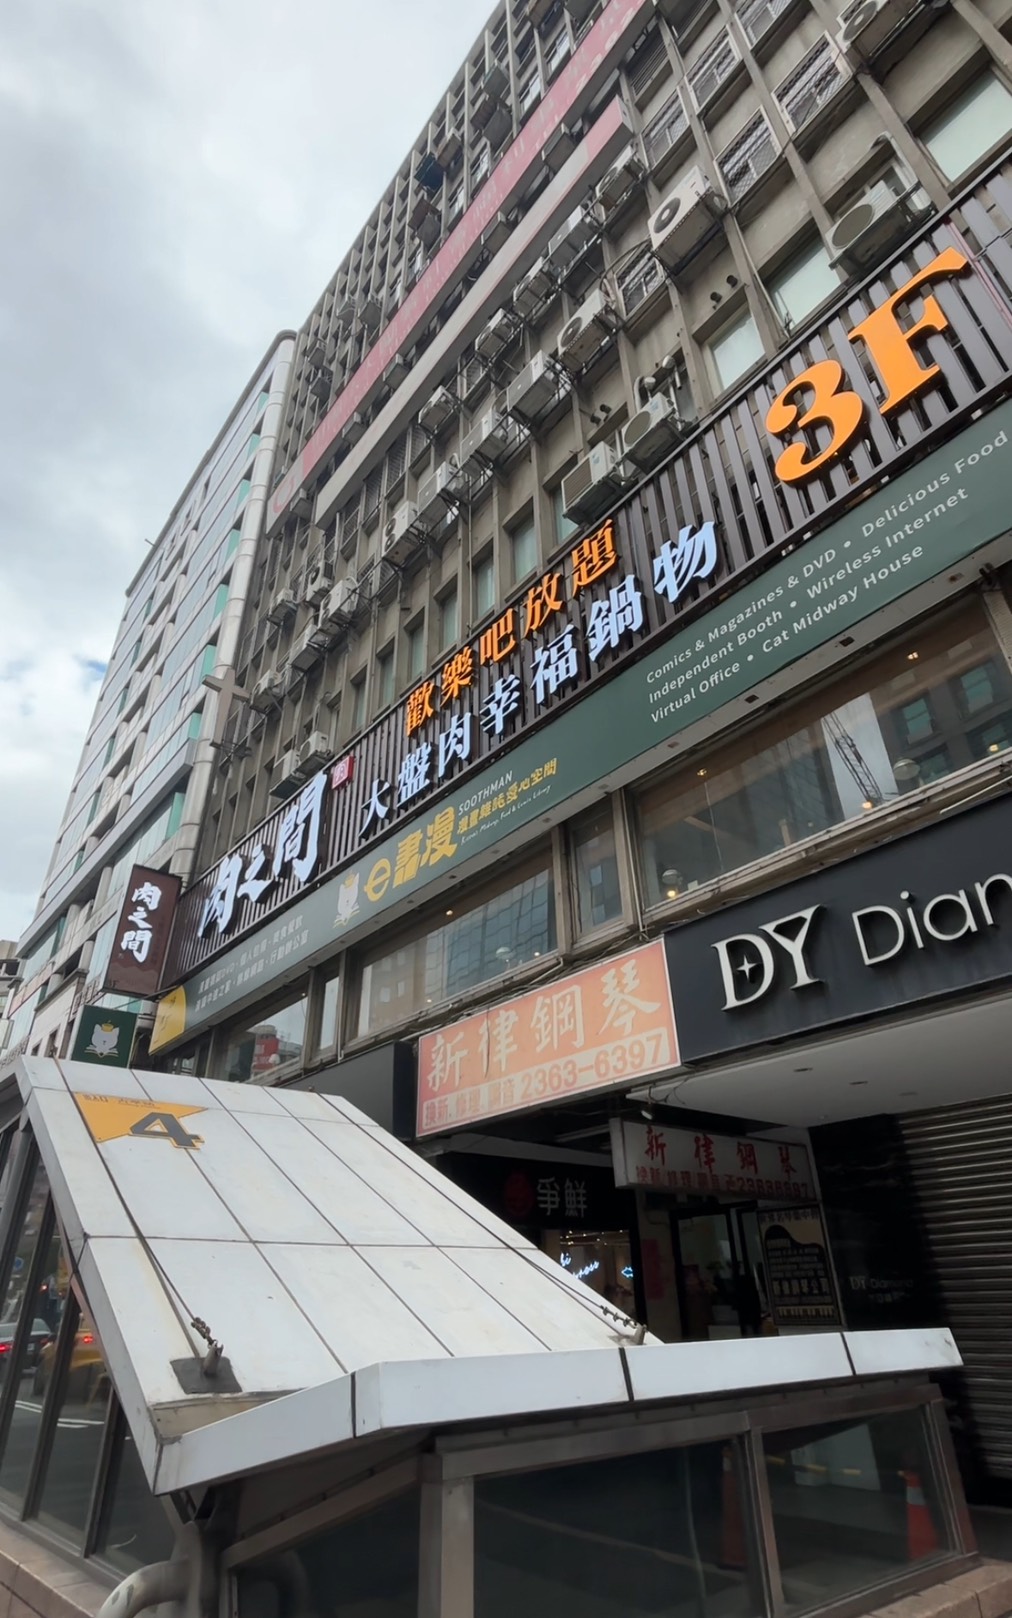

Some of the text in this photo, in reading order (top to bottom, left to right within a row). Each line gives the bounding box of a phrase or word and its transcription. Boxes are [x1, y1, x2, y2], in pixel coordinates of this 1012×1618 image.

[765, 246, 971, 482] 3F
[405, 518, 618, 737] 歡樂吧放題
[646, 430, 1009, 683] Comics & Magazines & DVD Delicious Food
[649, 487, 969, 703] Independent Booth Wireless Internet
[650, 545, 924, 723] Virtual Office Cat Midway House
[358, 520, 717, 836] 大盤肉幸福鍋物
[458, 770, 513, 816] SOOTHMAN
[120, 881, 162, 963] 肉之間
[711, 903, 826, 1012] DY
[427, 958, 662, 1093] 新律鋼琴
[520, 1035, 665, 1098] 2363-6397
[536, 1176, 588, 1218] 爭鮮
